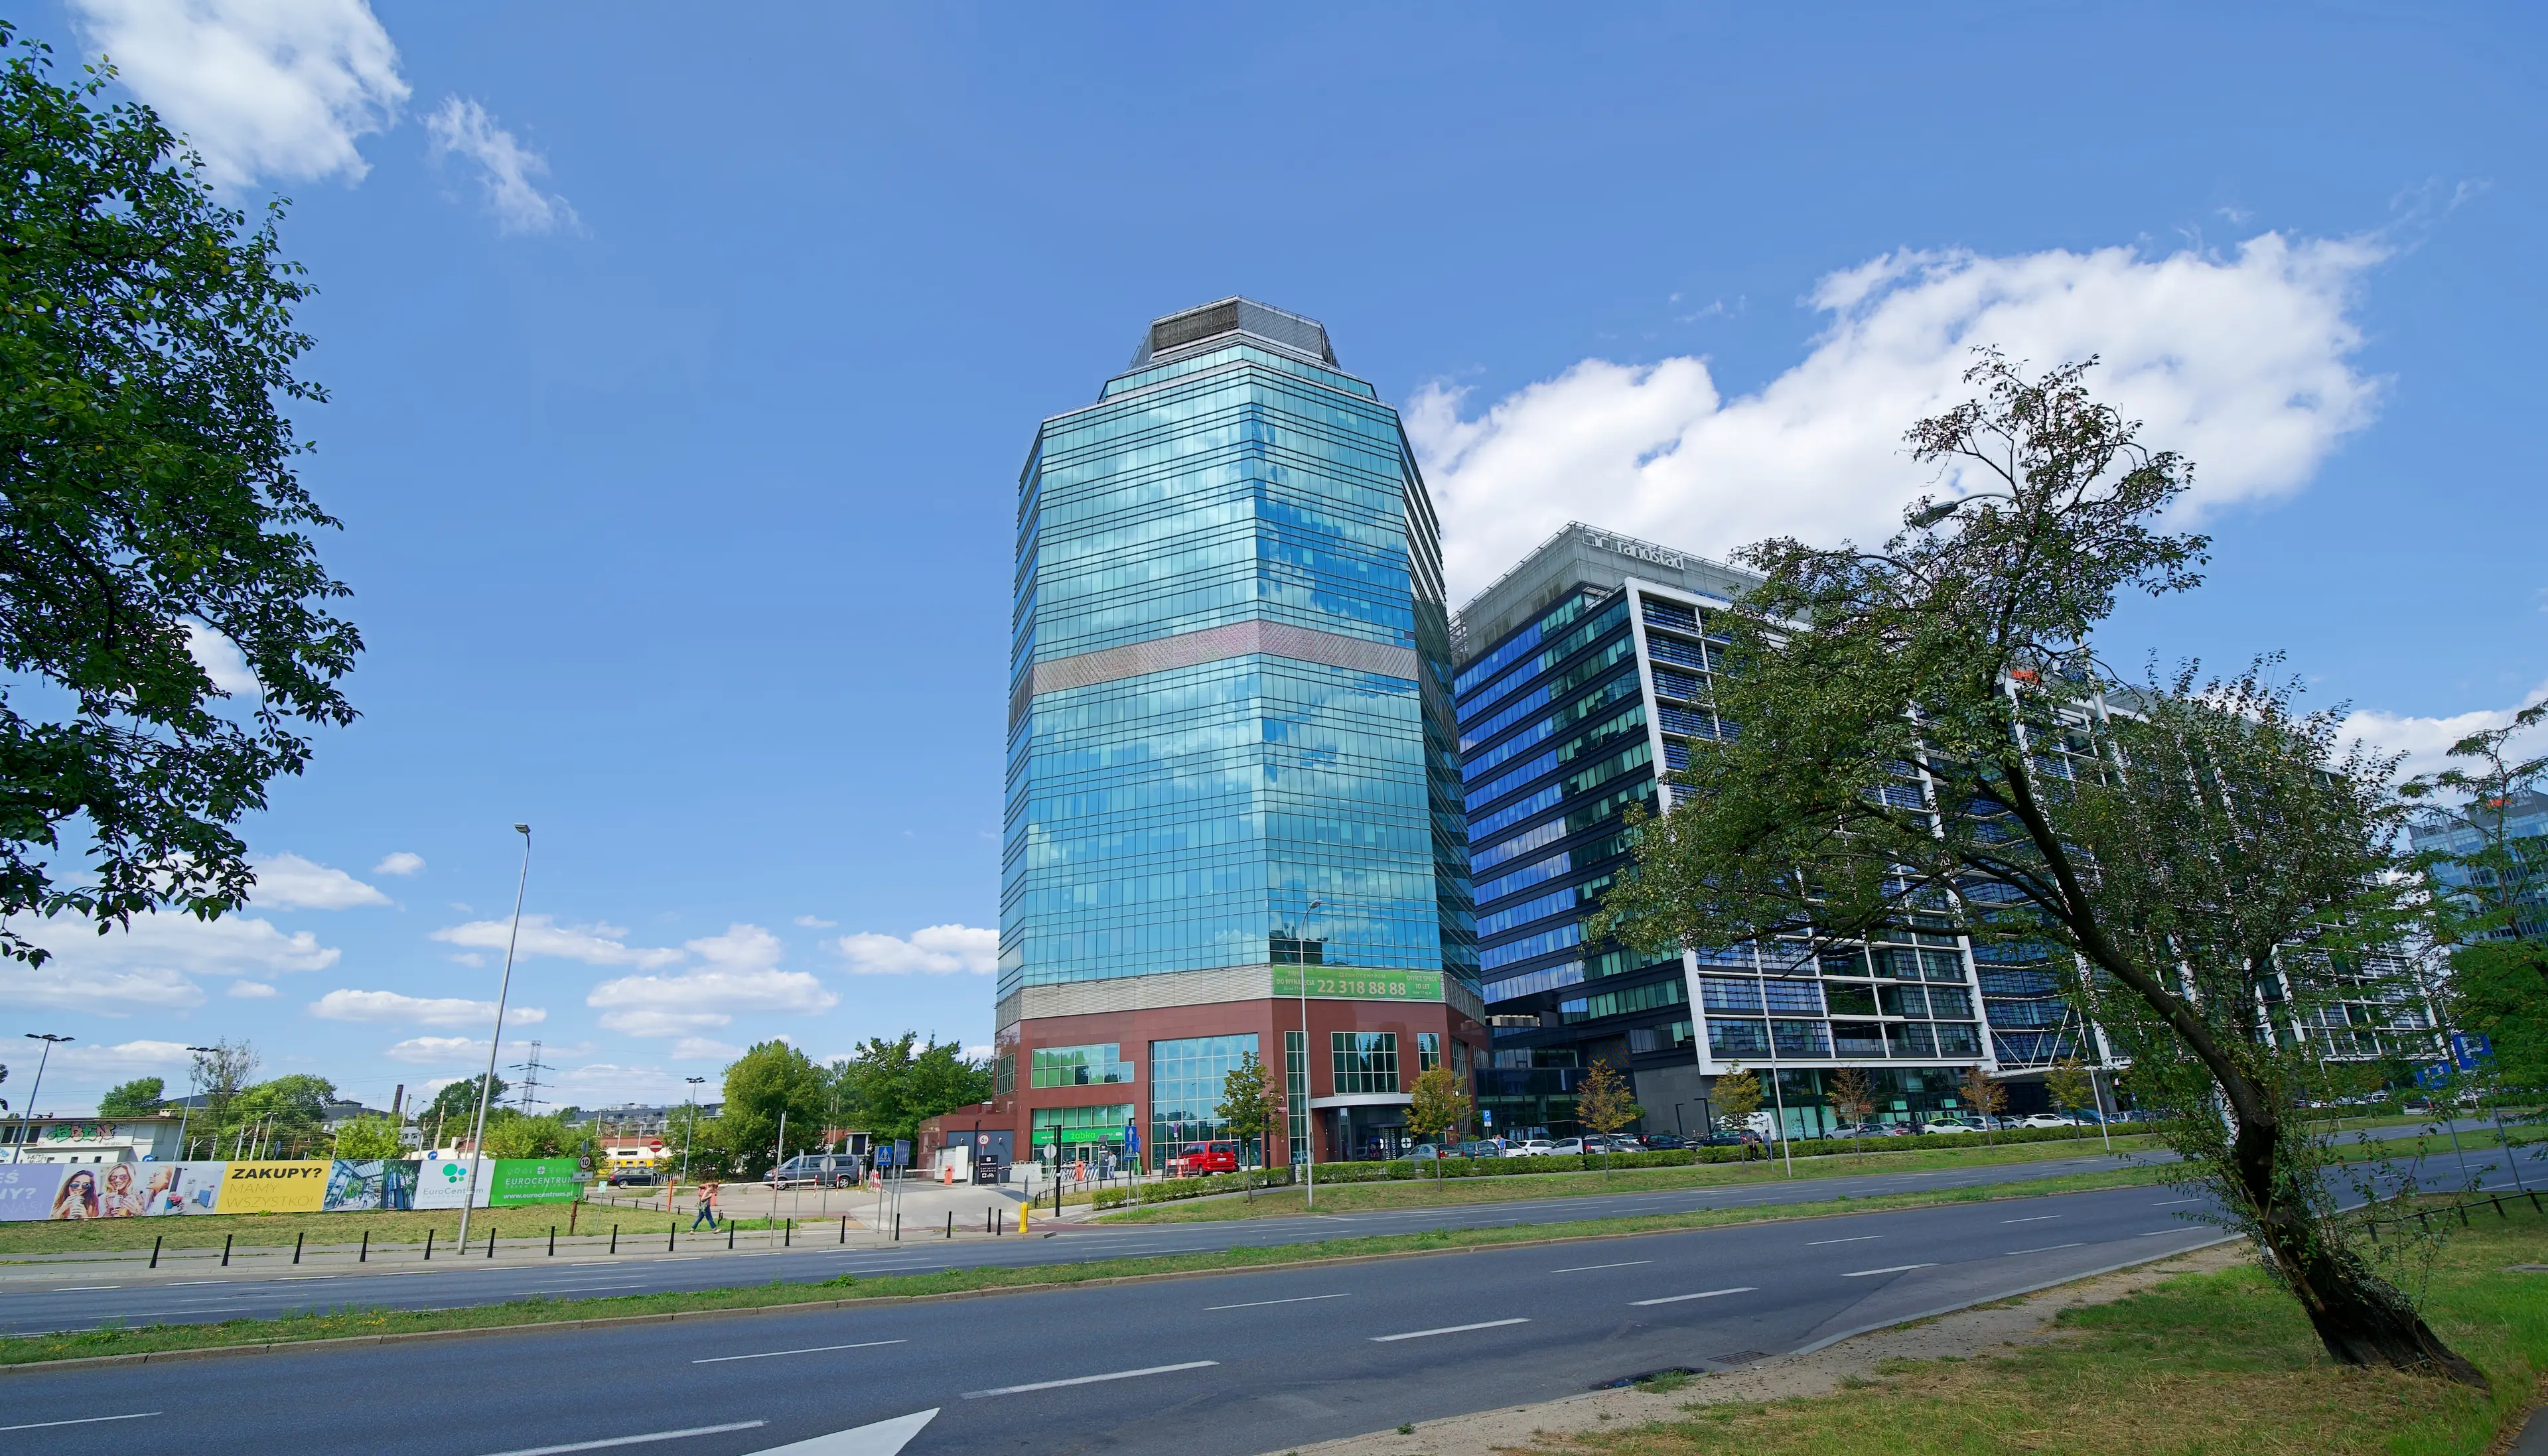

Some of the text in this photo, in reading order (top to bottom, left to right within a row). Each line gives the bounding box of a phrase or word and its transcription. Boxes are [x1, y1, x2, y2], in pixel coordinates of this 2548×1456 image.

[1617, 540, 1685, 570] randstad
[1318, 980, 1406, 995] 22 318 88 88
[1070, 1131, 1095, 1140] żabka
[232, 1167, 322, 1179] ZAKUPY?
[230, 1183, 279, 1194] MAMY
[1, 1201, 44, 1213] NAS!
[226, 1195, 314, 1208] WSZYSTKO!
